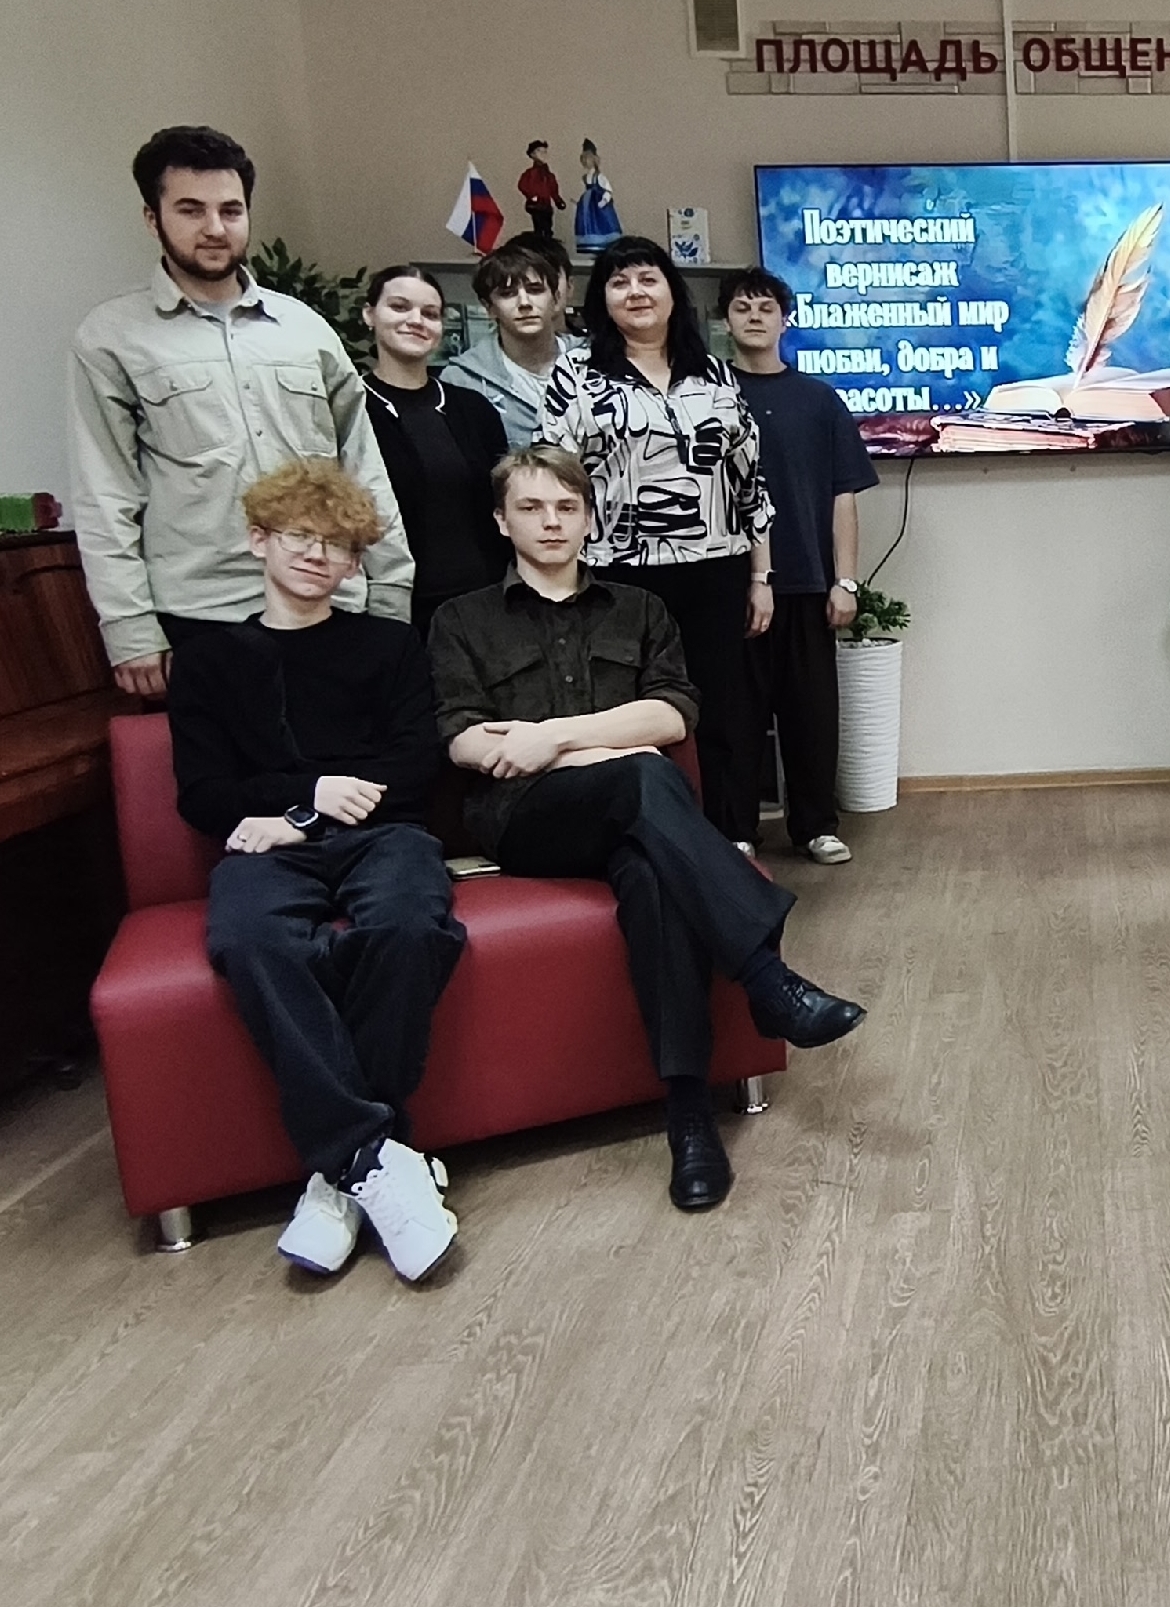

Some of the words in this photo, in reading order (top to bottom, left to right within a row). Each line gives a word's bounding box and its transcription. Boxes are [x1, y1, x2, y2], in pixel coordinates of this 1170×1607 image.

[755, 38, 998, 81] ПЛОЩАДЬ
[803, 209, 975, 244] Поэтический
[826, 261, 959, 295] вернисаж
[957, 300, 1010, 333] мир
[897, 340, 974, 378] добра
[980, 346, 999, 370] и
[836, 386, 981, 413] асоты...»
